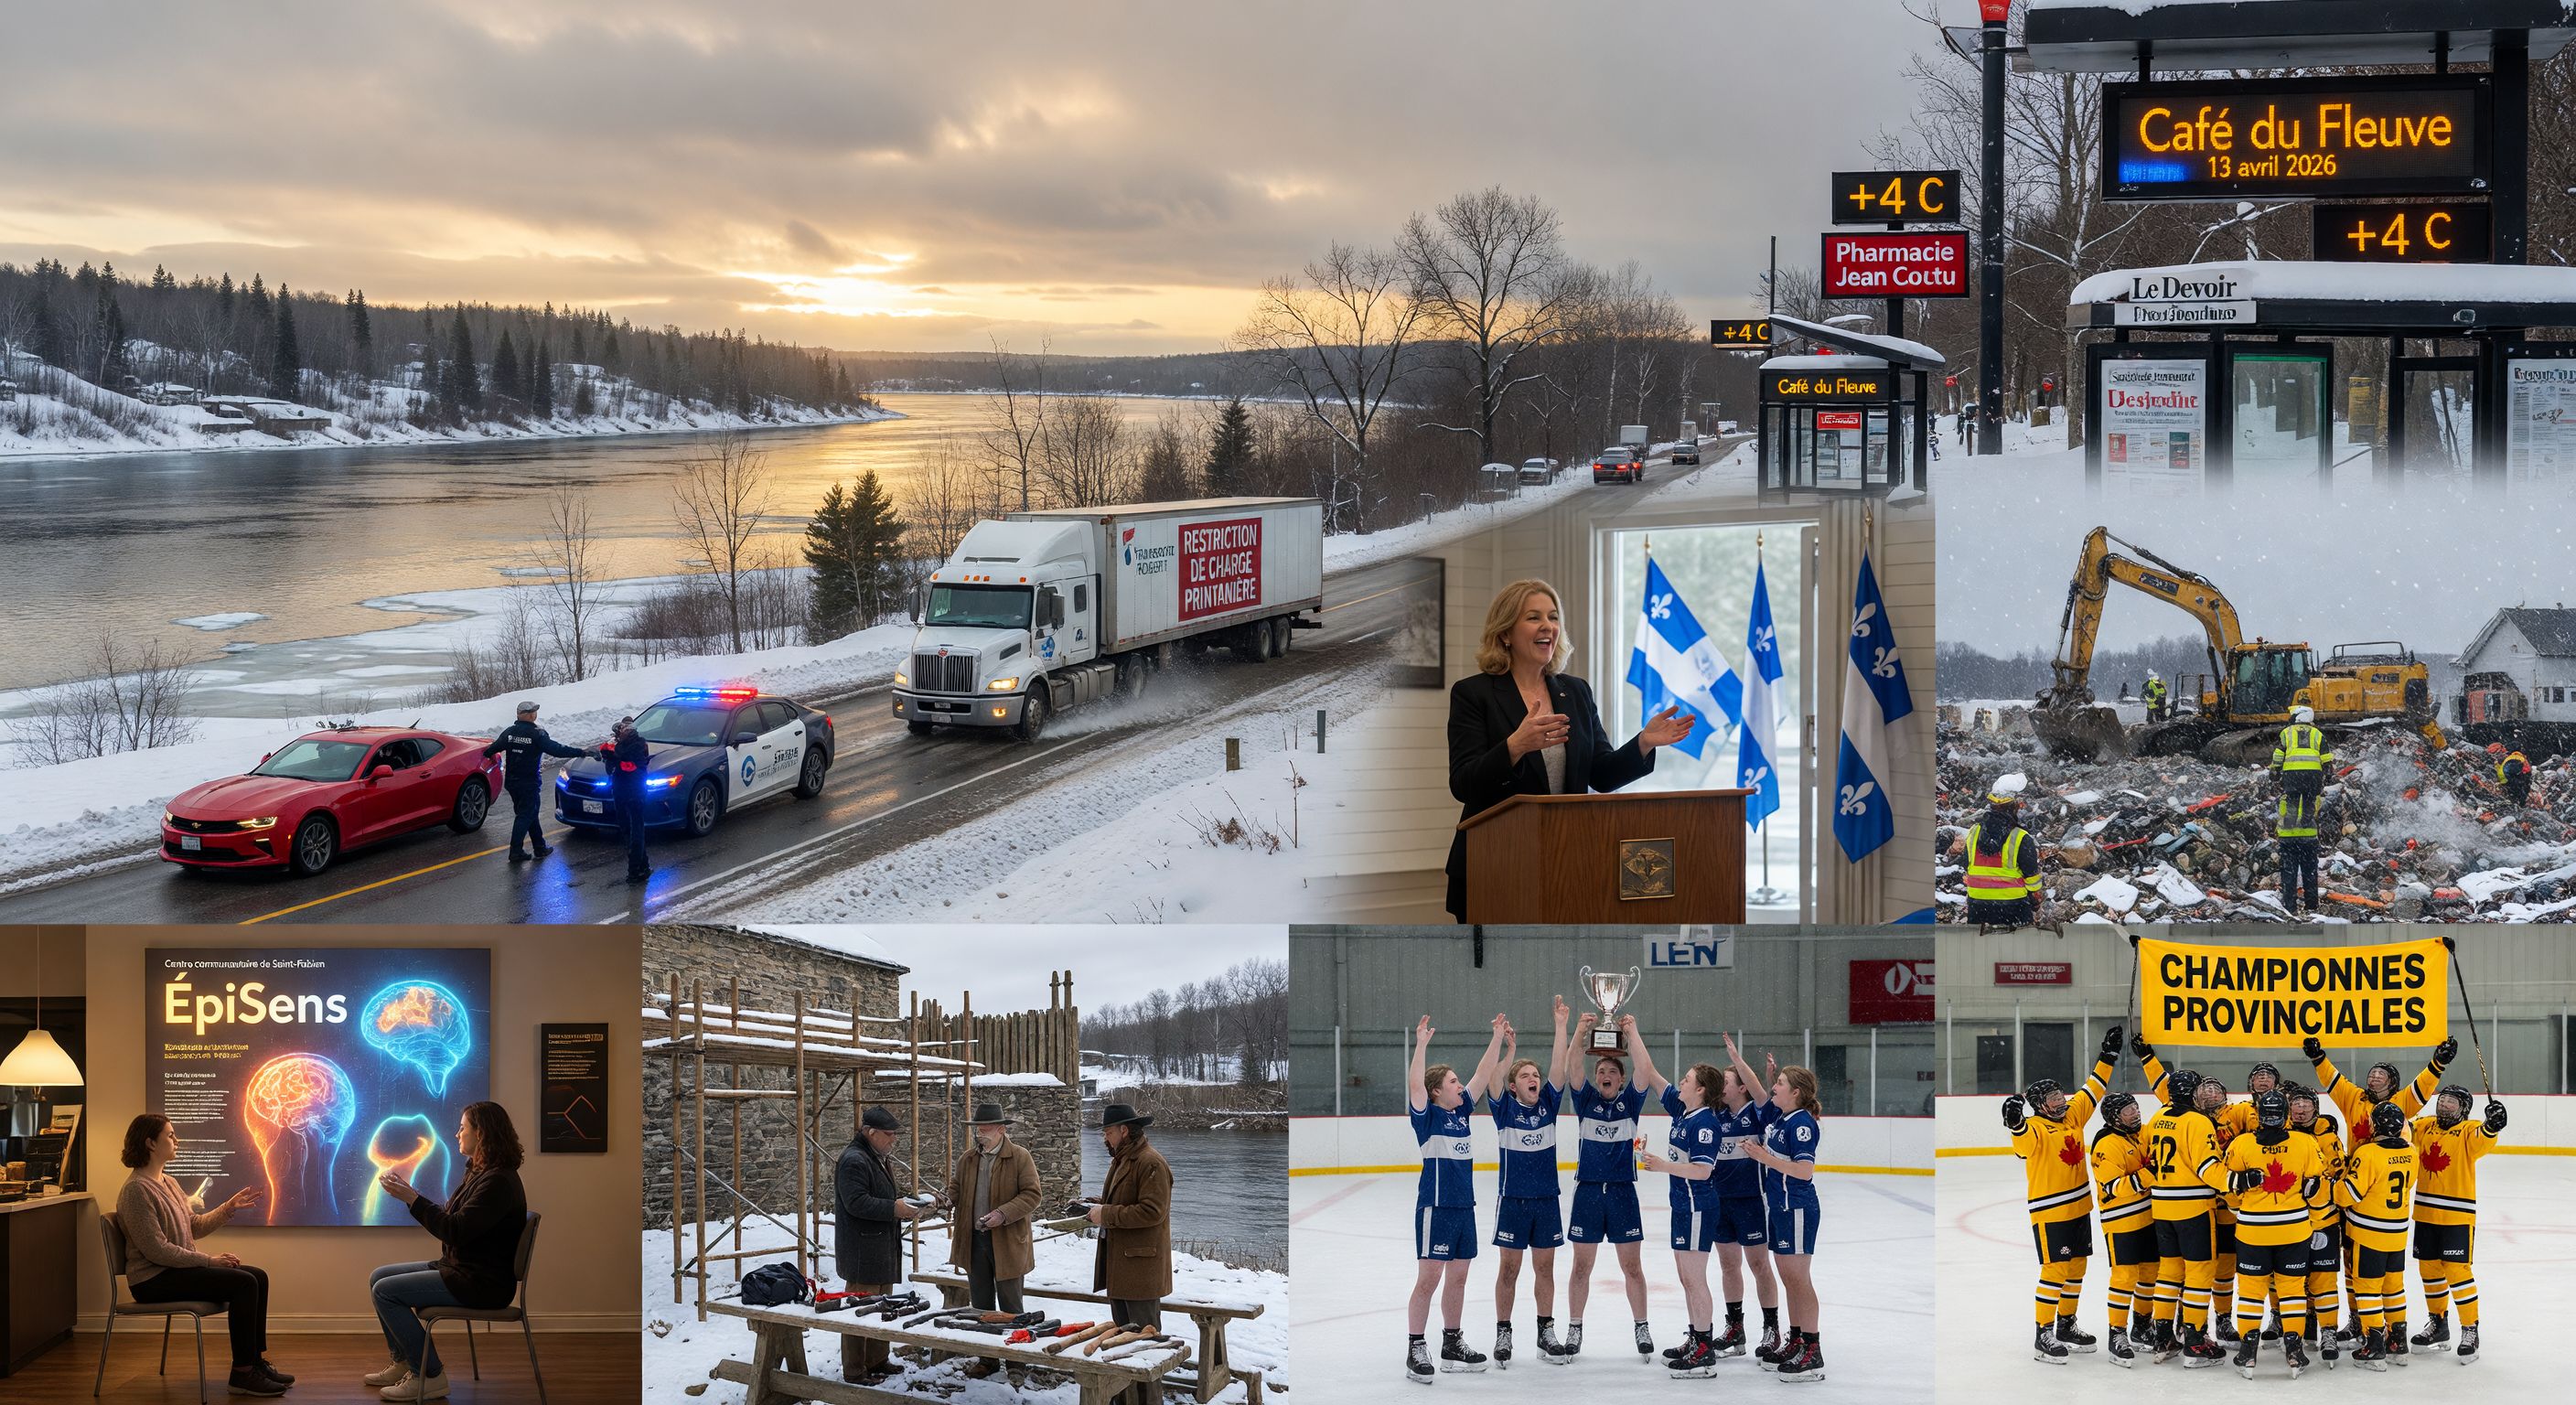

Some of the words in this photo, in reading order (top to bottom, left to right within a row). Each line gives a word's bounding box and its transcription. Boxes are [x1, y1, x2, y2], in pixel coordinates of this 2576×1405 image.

[2139, 105, 2233, 153] Café
[2250, 104, 2300, 150] du
[2319, 102, 2453, 148] Fleuve
[2208, 156, 2231, 178] 13
[2238, 155, 2279, 177] avril
[2286, 154, 2337, 177] 2026
[1849, 177, 1906, 215] +4
[1918, 177, 1944, 213] C
[2347, 213, 2410, 255] +4
[2424, 211, 2452, 250] C
[1836, 241, 1954, 263] Pharmacie
[1835, 266, 1887, 287] Jean
[2132, 277, 2159, 299] Le
[2162, 274, 2238, 299] Devoir
[1723, 324, 1752, 341] +4
[1756, 323, 1768, 340] C
[1777, 379, 1809, 394] Café
[1814, 379, 1832, 394] du
[1184, 524, 1258, 555] RESTRICTION
[1190, 557, 1207, 583] DE
[1208, 551, 1253, 580] CHARGE
[2160, 953, 2425, 992] CHAMPIONNES
[165, 971, 348, 1035] ÉpiSens
[2163, 996, 2426, 1035] PROVINCIALES
